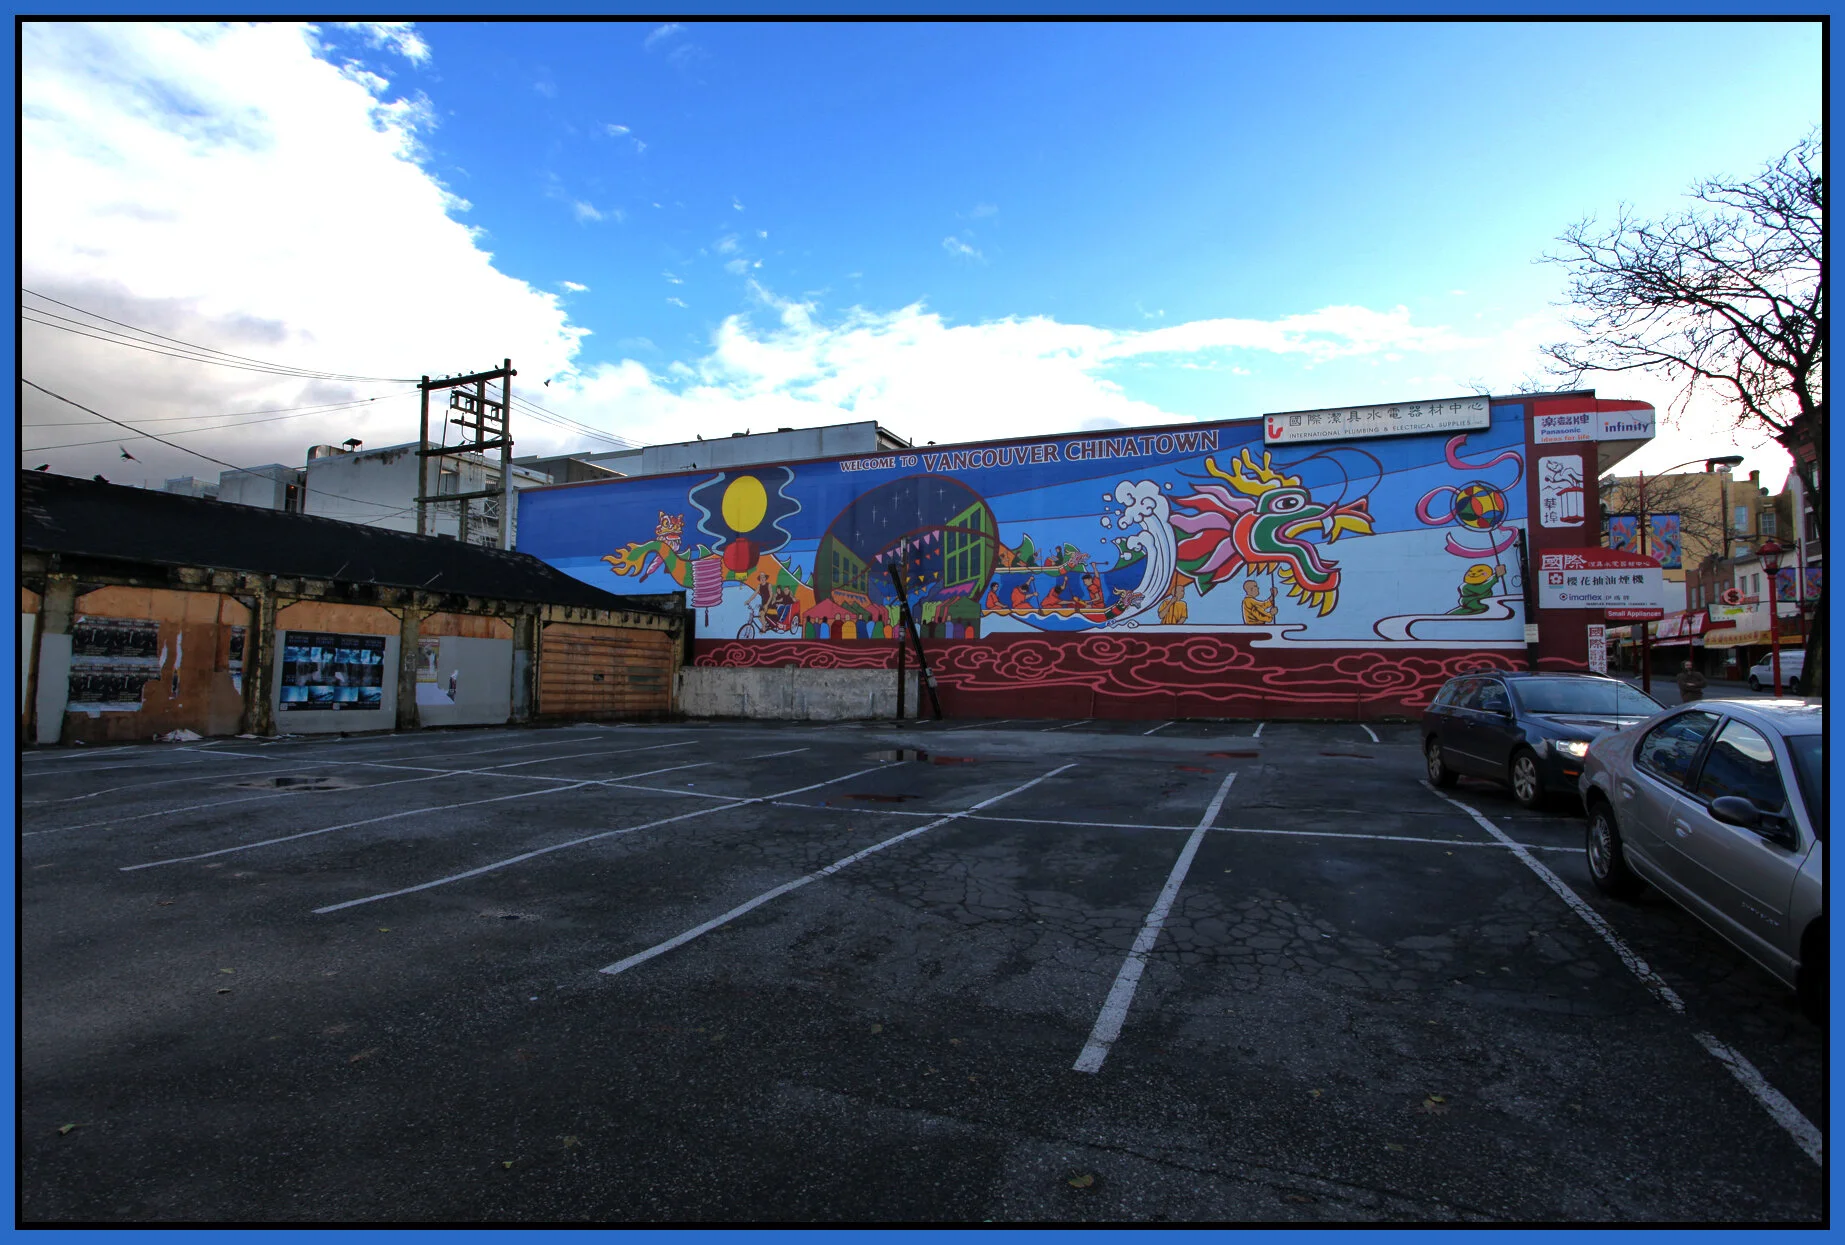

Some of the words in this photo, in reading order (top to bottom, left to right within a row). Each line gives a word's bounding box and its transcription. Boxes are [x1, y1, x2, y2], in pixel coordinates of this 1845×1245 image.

[1289, 403, 1484, 426] 國際潔具水電器材中心
[1289, 429, 1341, 439] INTERNATIONAL
[1344, 426, 1380, 435] PLUMBING
[1392, 423, 1435, 432] ELECTRICAL
[1438, 420, 1471, 428] SUPPLIES
[1541, 428, 1581, 436] Panasonic
[1604, 421, 1650, 433] infinity
[1578, 433, 1591, 441] life
[840, 457, 896, 472] WELCOME
[899, 455, 917, 468] TO
[922, 441, 1061, 473] VANCOUVER
[1063, 430, 1219, 462] CHINATOWN
[1543, 497, 1558, 524] 華埠
[1542, 554, 1587, 570] 國際
[1568, 593, 1602, 601] imarflex
[1589, 627, 1605, 648] 國際
